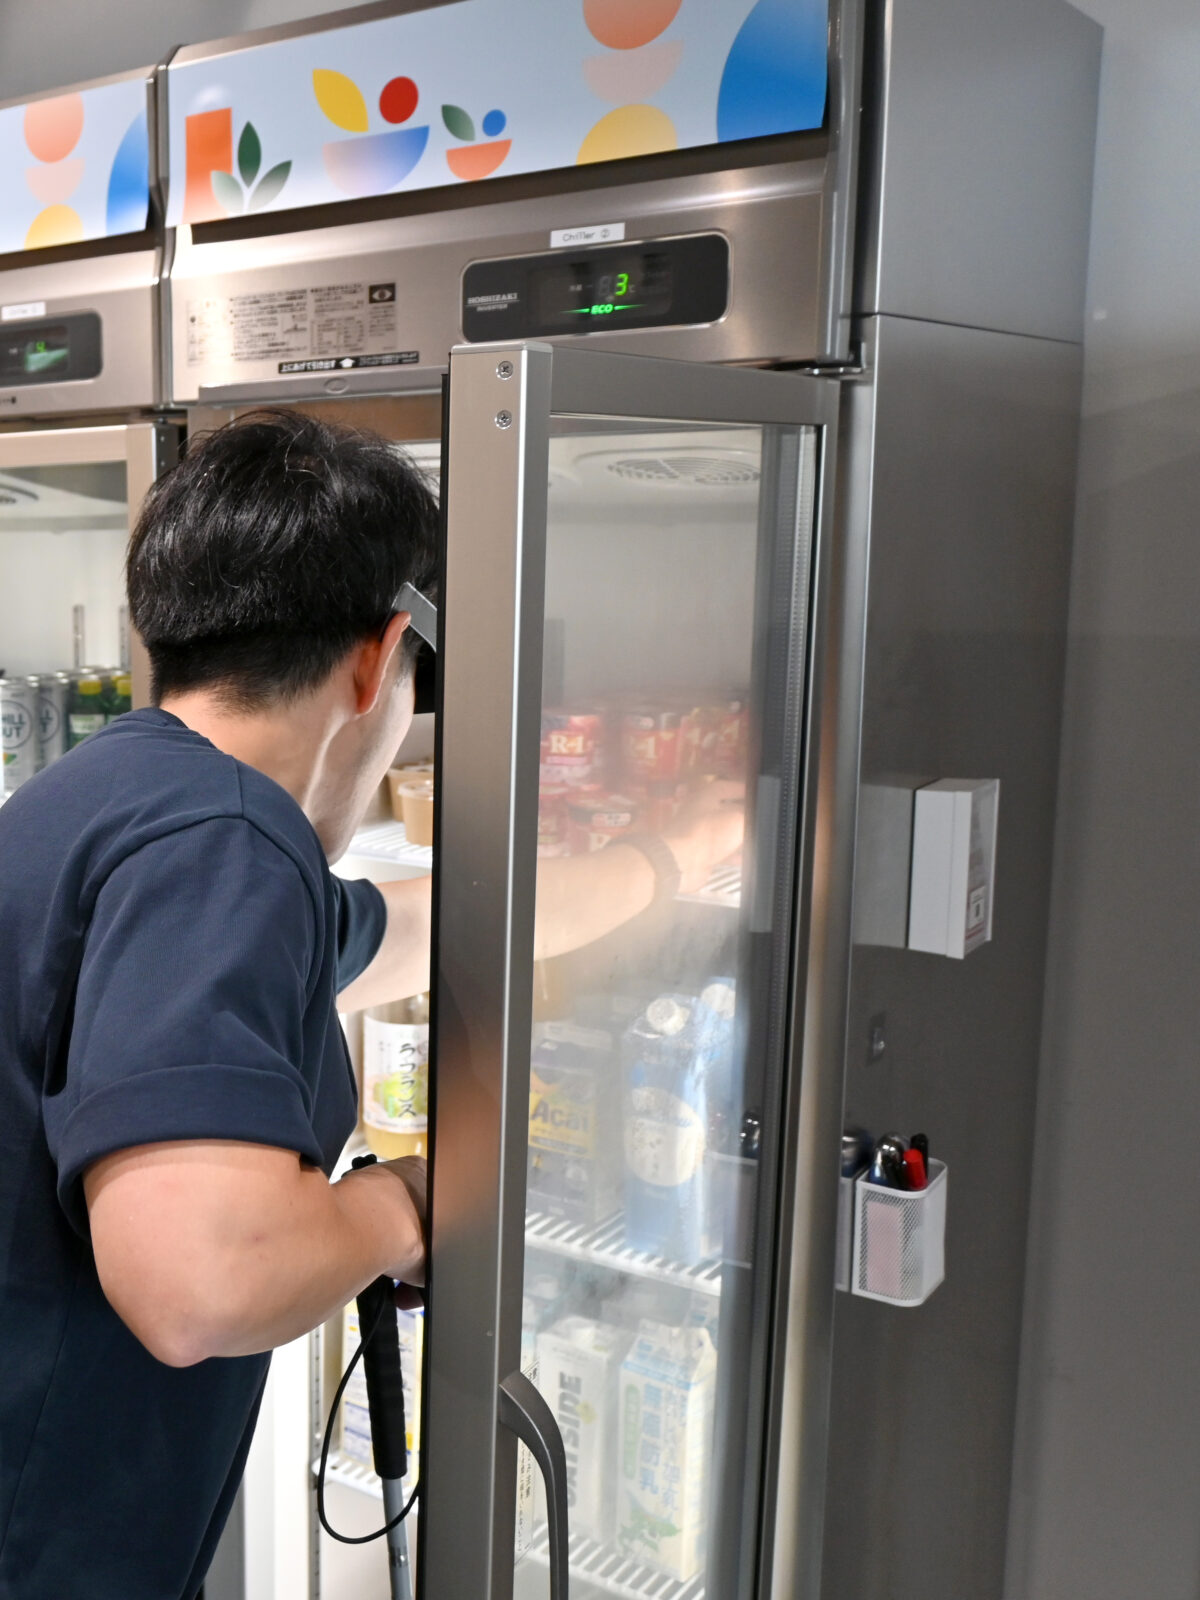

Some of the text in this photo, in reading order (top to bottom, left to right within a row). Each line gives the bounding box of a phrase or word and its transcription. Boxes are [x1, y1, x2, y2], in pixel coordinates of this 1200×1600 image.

[562, 231, 596, 242] Chiller
[614, 272, 629, 296] 3
[468, 293, 518, 304] HOSHIZAKI
[591, 304, 614, 315] ECO
[549, 733, 585, 754] R-1
